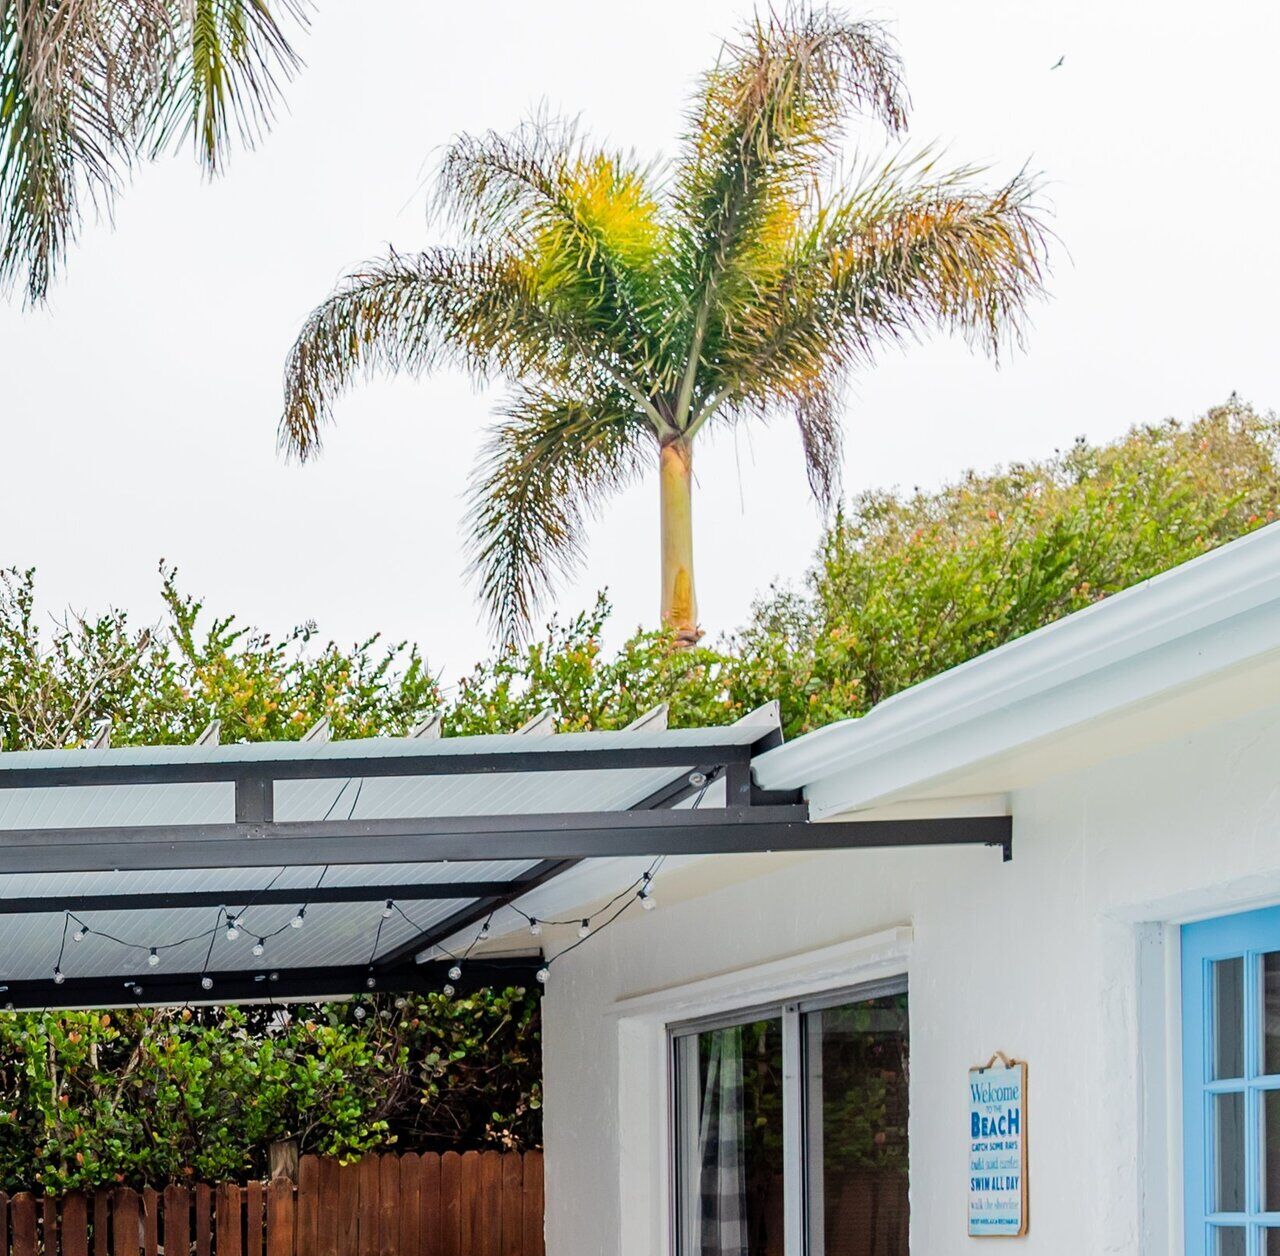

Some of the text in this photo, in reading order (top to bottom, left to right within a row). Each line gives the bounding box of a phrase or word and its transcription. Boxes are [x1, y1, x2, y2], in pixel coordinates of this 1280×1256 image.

[971, 1083, 1019, 1104] Welcome
[971, 1108, 1019, 1138] BEACH
[972, 1140, 1018, 1152] CATCH SOME RAYS
[971, 1176, 1019, 1191] SWIM ALL DAY
